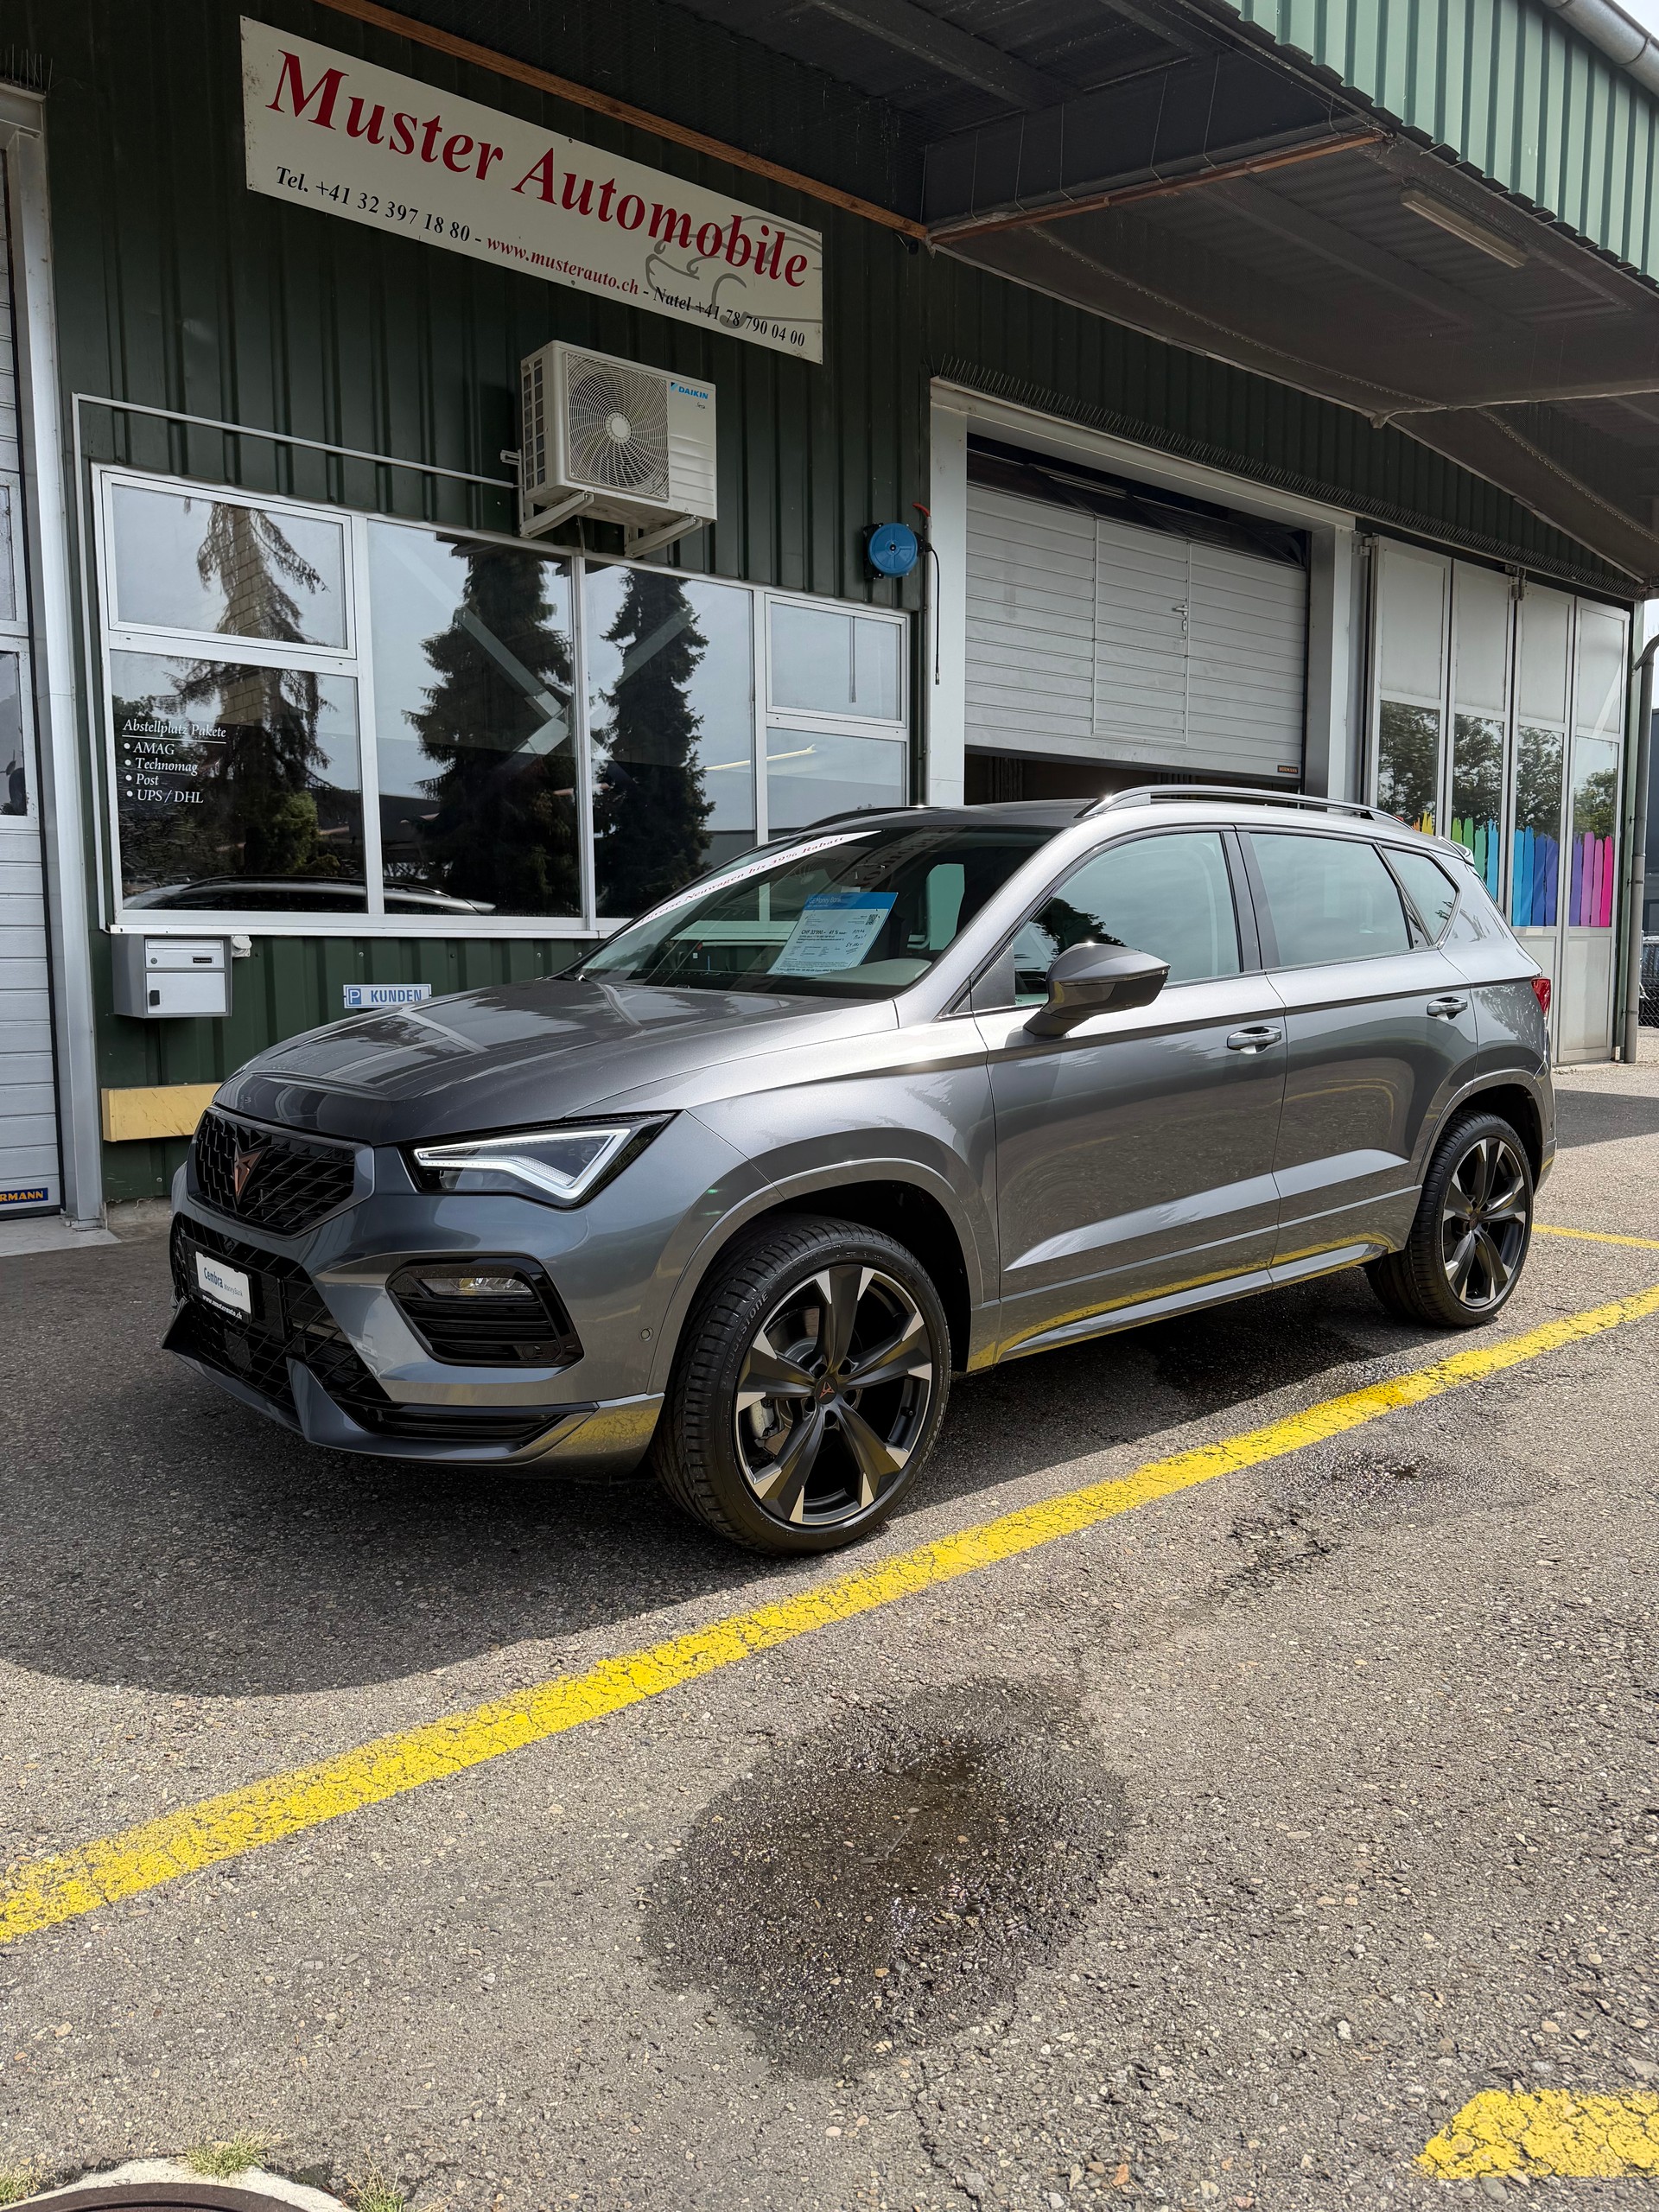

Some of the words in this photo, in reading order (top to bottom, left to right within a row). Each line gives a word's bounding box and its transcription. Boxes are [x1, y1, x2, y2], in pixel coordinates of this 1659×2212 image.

[265, 49, 504, 181] Muster
[511, 147, 808, 287] Automobile
[276, 166, 308, 193] Tel.
[315, 181, 350, 205] +41
[357, 192, 379, 213] 32
[385, 201, 418, 225] 397
[423, 213, 444, 234] 18
[449, 221, 470, 242] 80
[487, 238, 639, 295] www.musterauto.ch
[653, 286, 691, 312] Natel
[695, 302, 721, 321] +41
[726, 308, 741, 327] 78
[745, 315, 768, 335] 790
[772, 324, 786, 341] 04
[790, 330, 805, 347] 00
[678, 386, 709, 399] DAIKIN
[123, 719, 188, 737] Abstellplatz
[191, 724, 226, 737] Pakete
[133, 742, 175, 755] AMAG
[135, 758, 198, 776] Technomag
[136, 773, 160, 785] Post
[137, 789, 162, 802] UPS
[174, 791, 204, 804] DHL
[684, 873, 745, 901] Neuwagen
[748, 864, 766, 874] bis
[802, 836, 844, 854] Rabatt
[371, 989, 422, 1003] KUNDEN
[204, 1267, 223, 1289] Cembra
[202, 1294, 243, 1320] www.musterauto.ch
